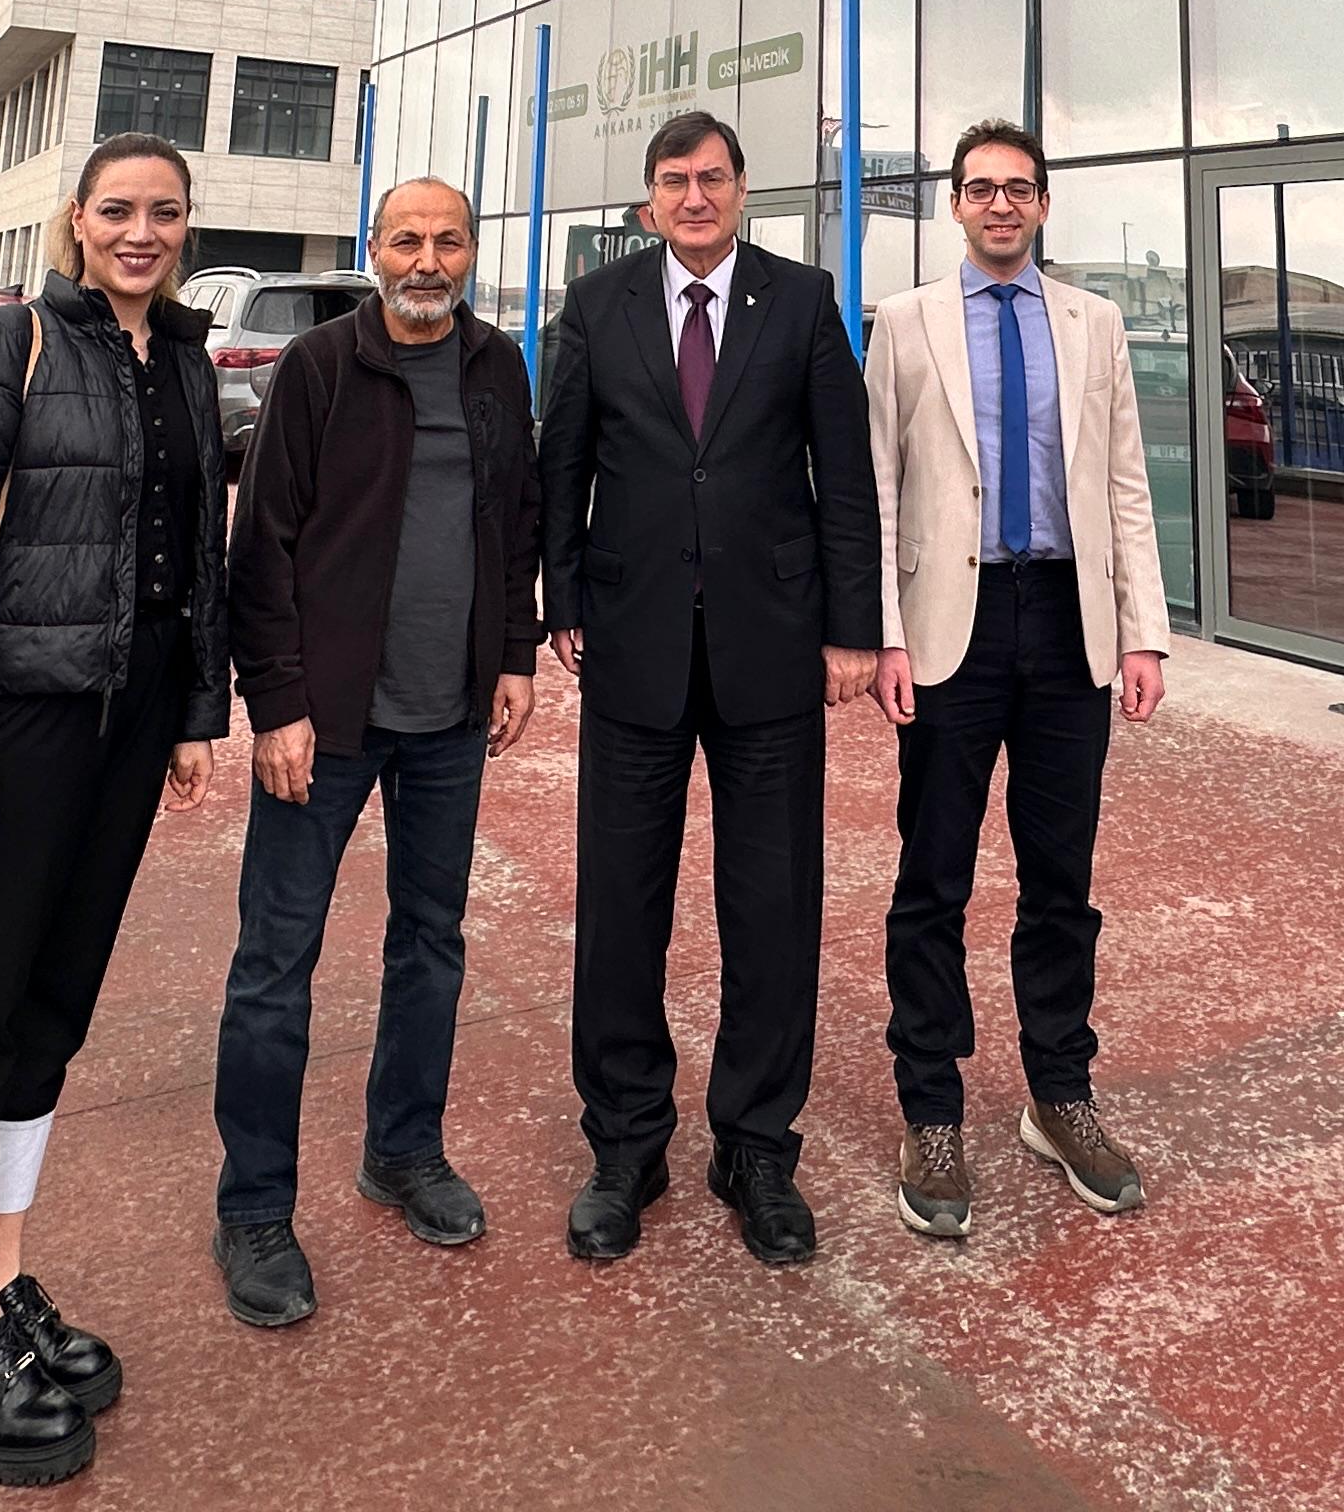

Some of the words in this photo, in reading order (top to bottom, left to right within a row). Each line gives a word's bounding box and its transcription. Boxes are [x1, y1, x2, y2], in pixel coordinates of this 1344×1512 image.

[719, 46, 790, 79] OSTM-İVEDİK
[594, 117, 642, 139] ANKARA
[650, 103, 696, 132] ŞUB
